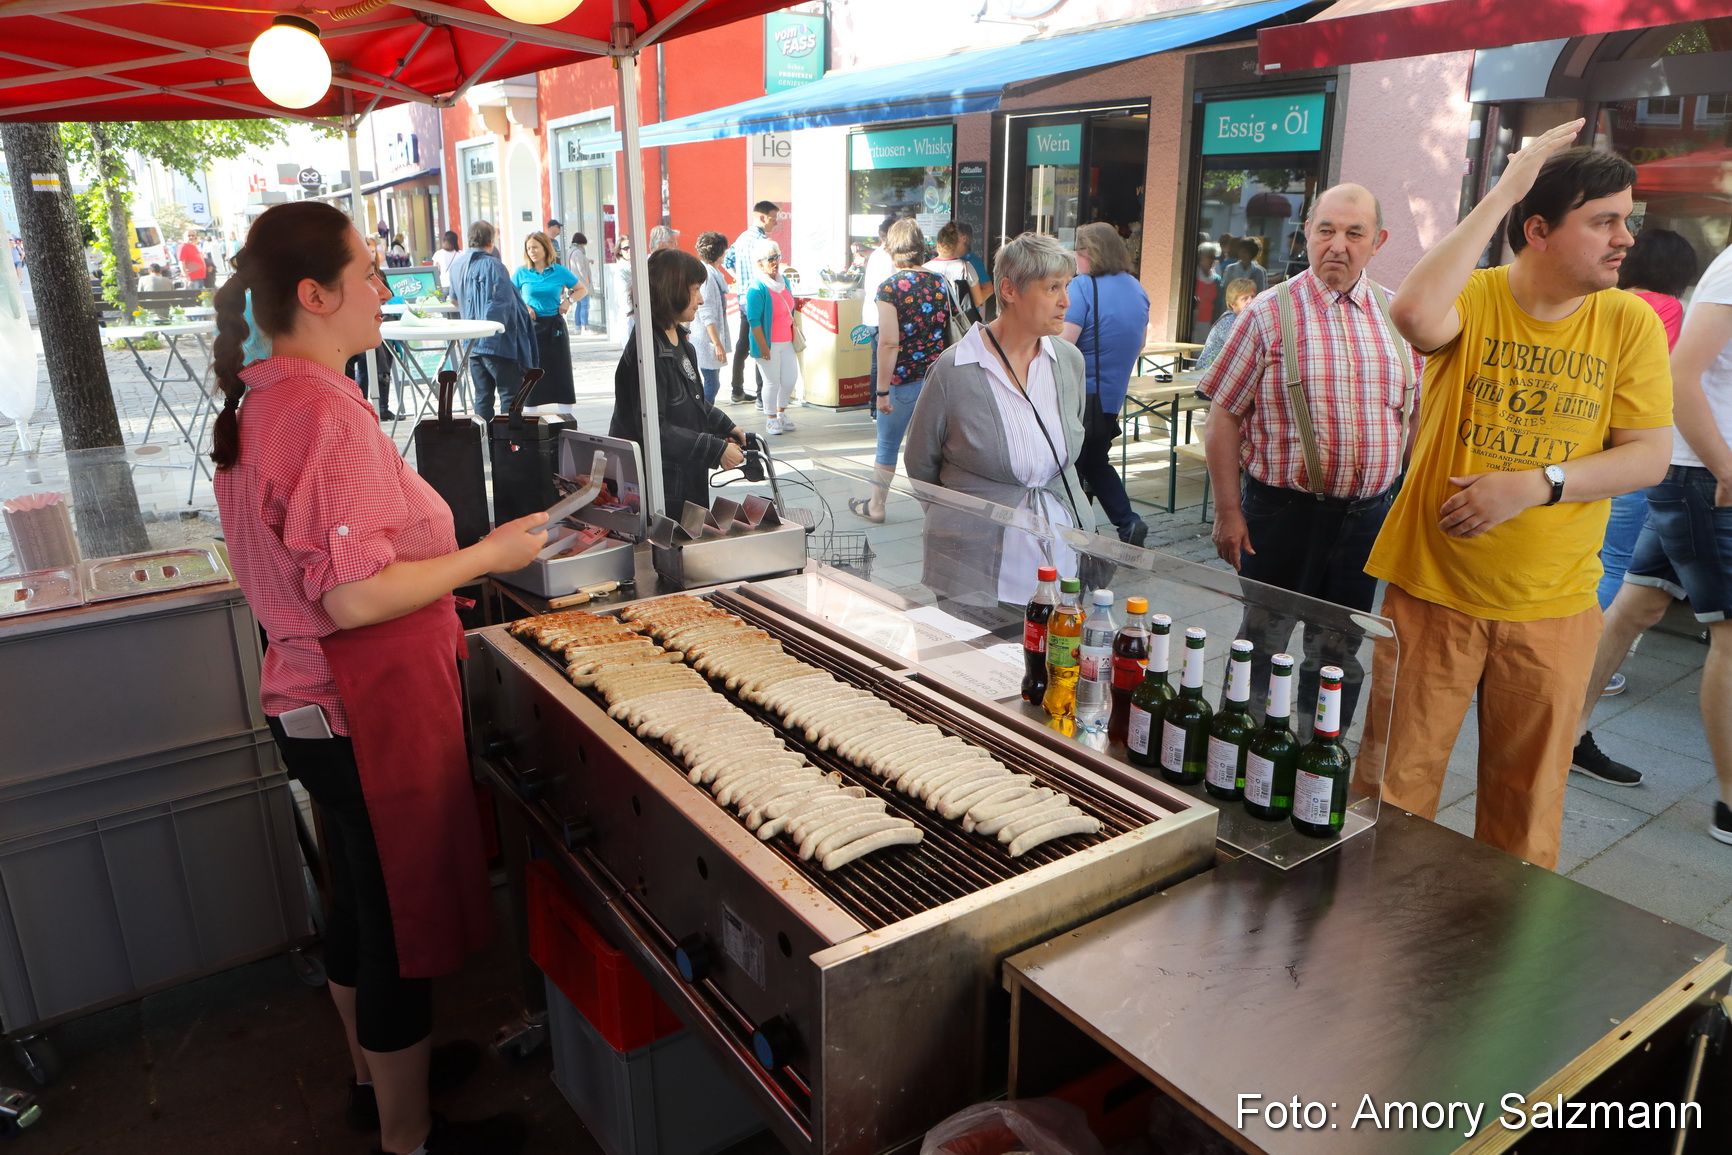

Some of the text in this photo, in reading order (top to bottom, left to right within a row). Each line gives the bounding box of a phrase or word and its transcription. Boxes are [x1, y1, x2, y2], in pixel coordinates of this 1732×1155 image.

[775, 27, 797, 41] vom
[783, 34, 816, 55] FASS
[1218, 105, 1309, 142] Essig Öl
[871, 137, 953, 158] rituosen Whisky
[1037, 133, 1071, 152] Wein
[393, 279, 408, 289] vom
[400, 281, 422, 296] FASS
[1509, 377, 1559, 393] MASTER
[1466, 373, 1504, 403] LIITED
[1508, 389, 1548, 416] 62
[1554, 396, 1600, 420] EDITION
[1498, 409, 1547, 427] SERIES
[1506, 426, 1531, 436] FINEST
[1458, 418, 1580, 463] QUALITY
[1470, 447, 1548, 469] CREATED AND PRODUCE
[1486, 462, 1500, 471] TOM
